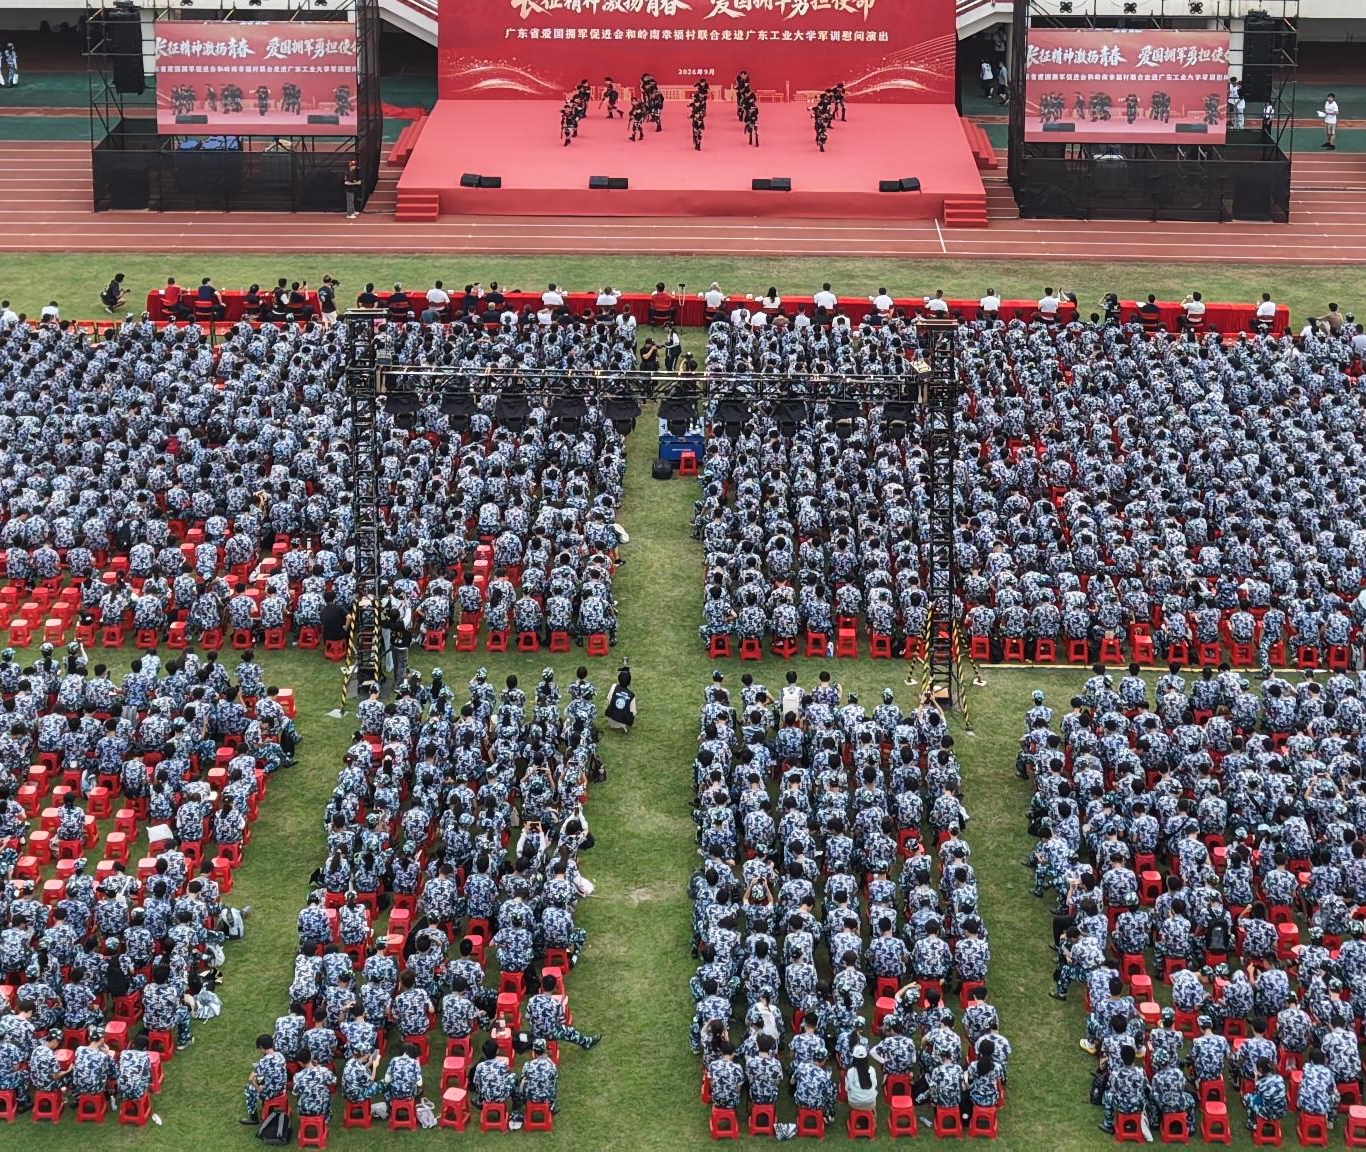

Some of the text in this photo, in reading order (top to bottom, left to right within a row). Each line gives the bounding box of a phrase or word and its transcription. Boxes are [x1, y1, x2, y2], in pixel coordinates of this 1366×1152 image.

[505, 27, 889, 42] 广东省爱国拥军促进会和岭南幸福村联合走进广东工业大学军训慰问演出
